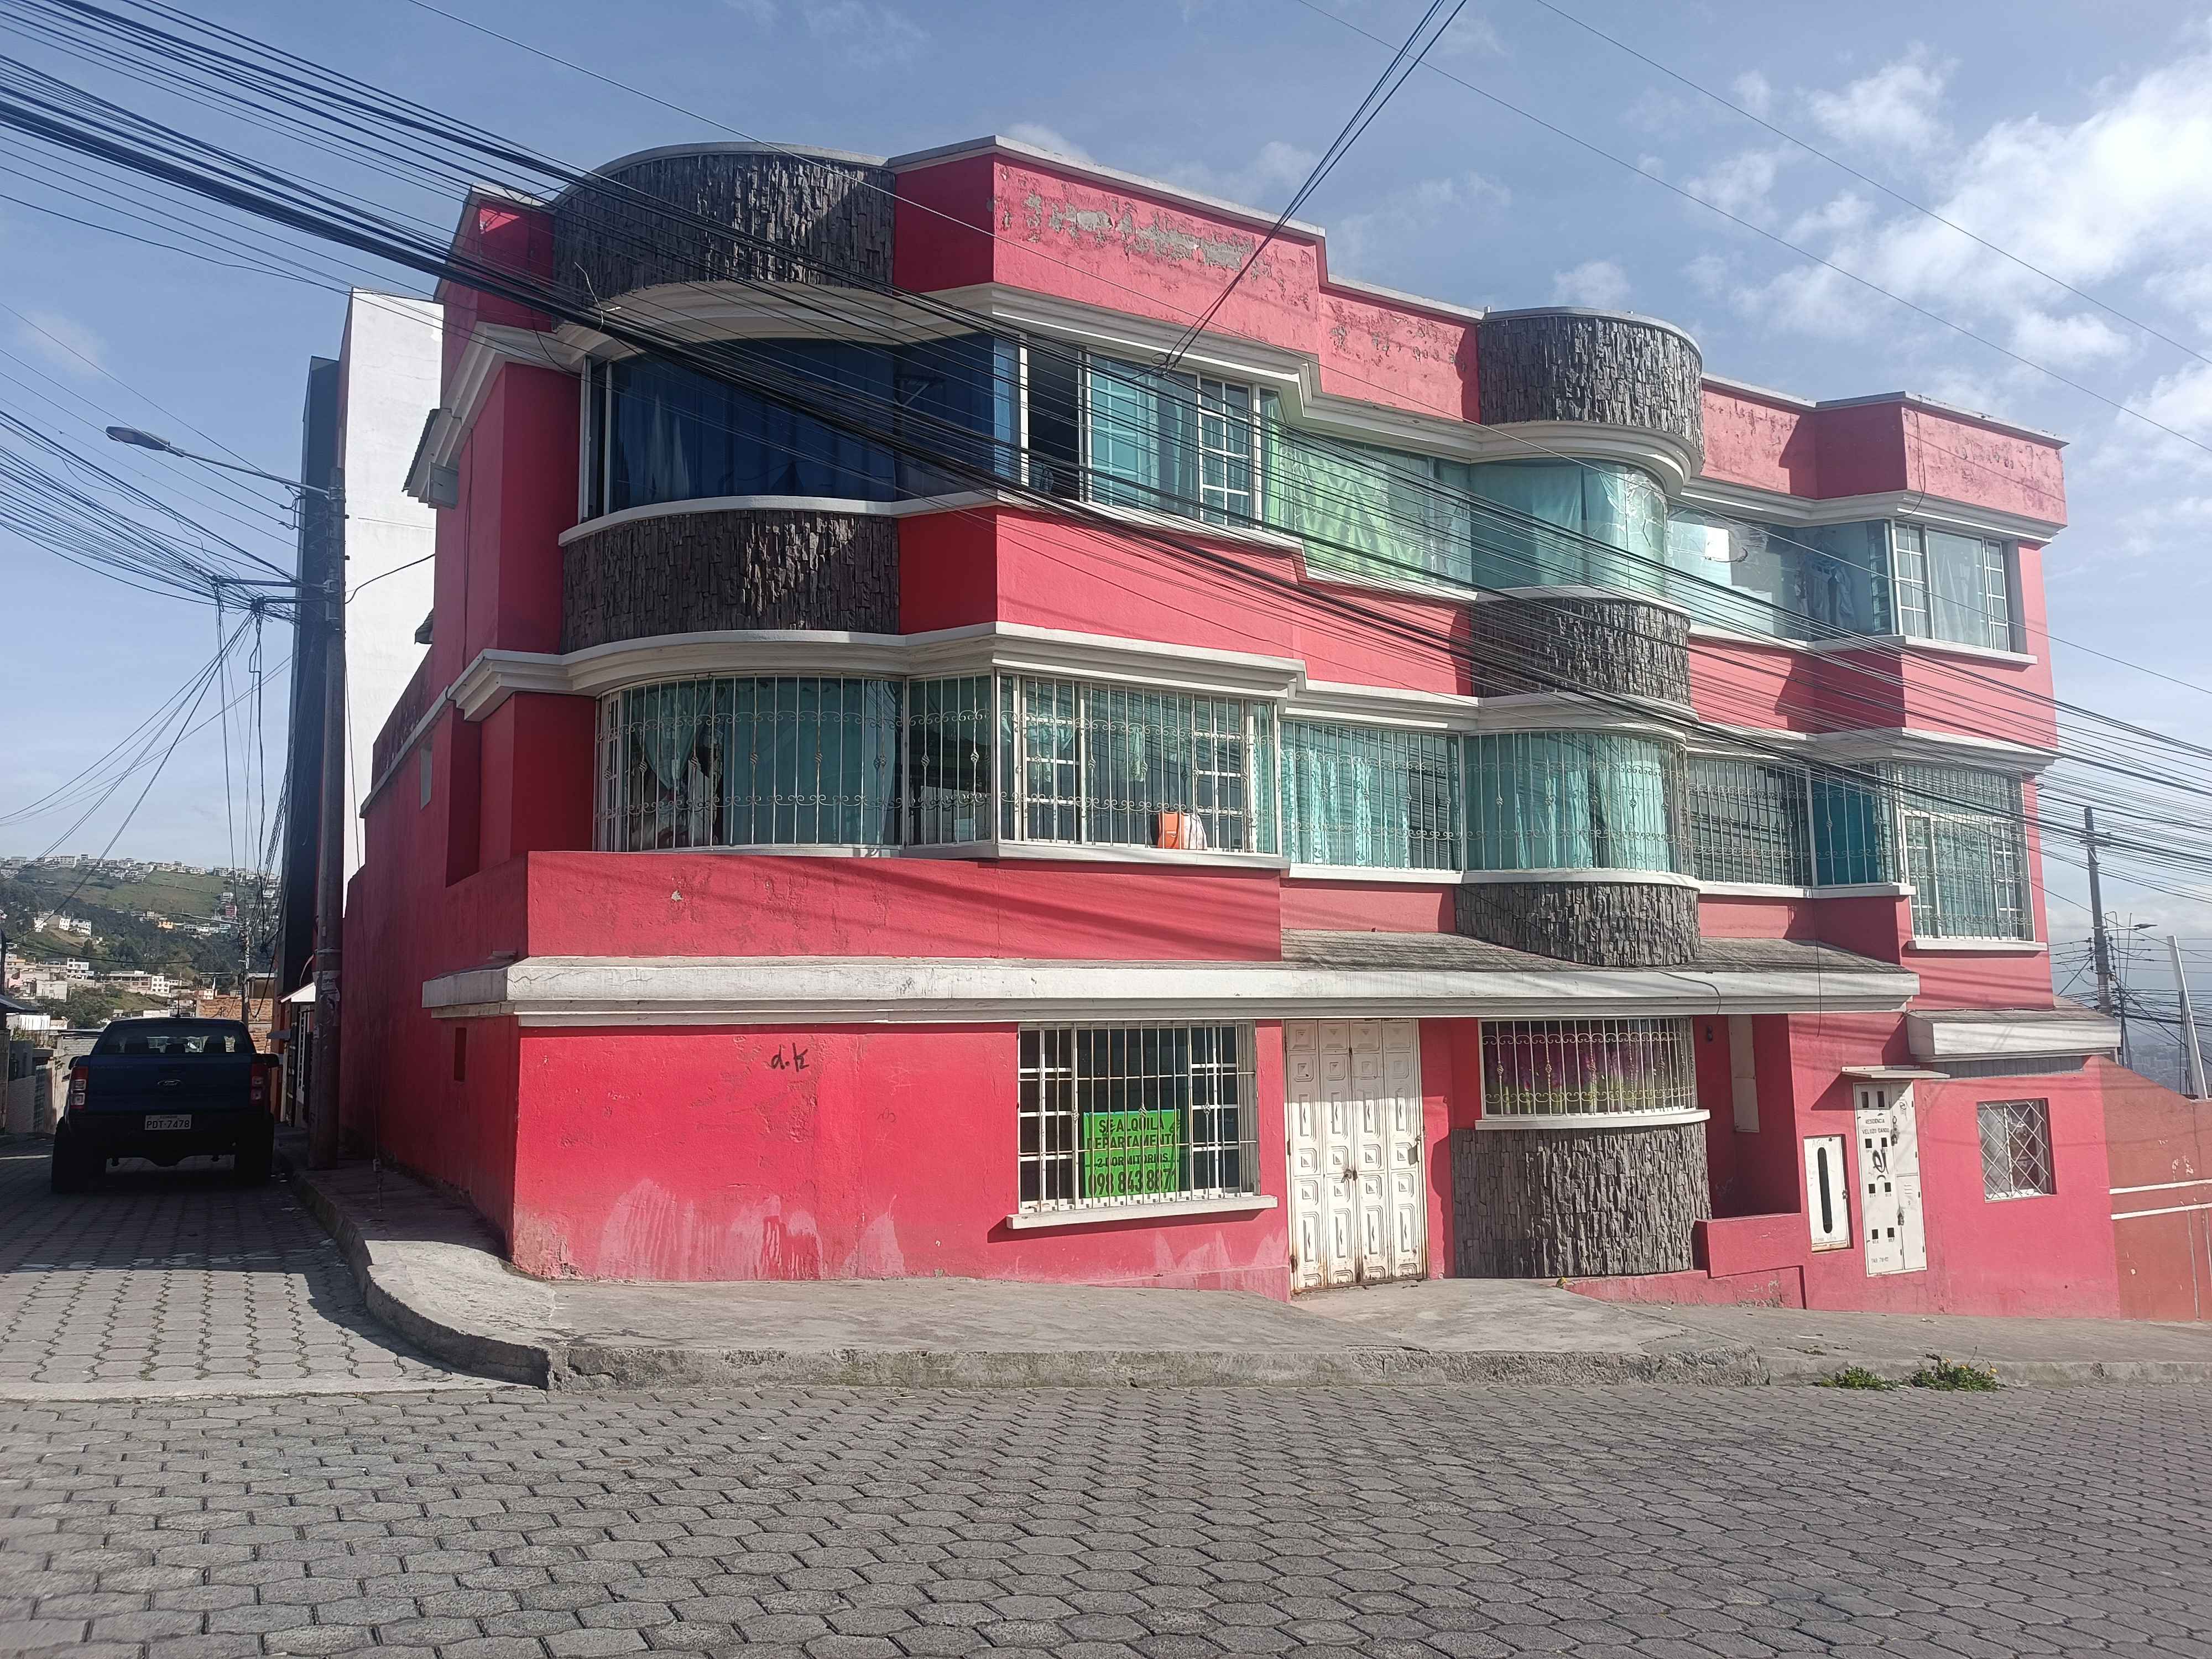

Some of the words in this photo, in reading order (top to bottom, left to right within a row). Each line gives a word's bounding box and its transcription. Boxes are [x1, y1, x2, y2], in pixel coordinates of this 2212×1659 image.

[146, 1120, 190, 1129] PDT-7478
[1098, 1119, 1114, 1133] SE
[1116, 1117, 1165, 1133] ALQUILA
[1087, 1133, 1179, 1150] DEPARTAMENTO
[1105, 1152, 1168, 1167] DORMITORIOS
[1088, 1172, 1114, 1196] 098
[1118, 1170, 1143, 1193] 843
